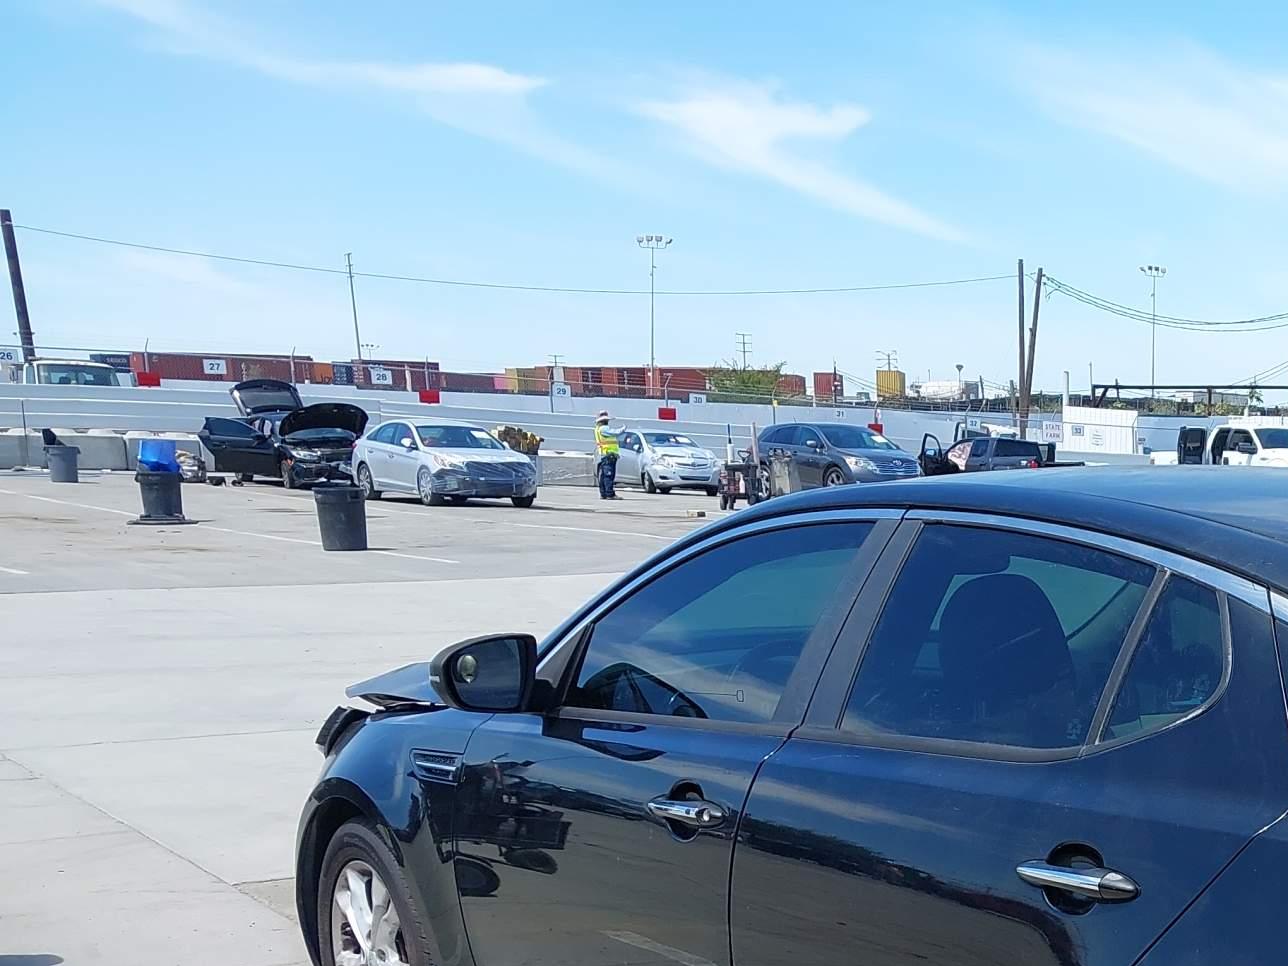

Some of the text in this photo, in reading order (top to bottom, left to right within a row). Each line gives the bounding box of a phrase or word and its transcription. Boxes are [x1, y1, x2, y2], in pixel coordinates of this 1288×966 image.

[0, 352, 13, 360] 26
[209, 363, 221, 371] 27
[376, 373, 387, 382] 28
[556, 387, 567, 395] 29
